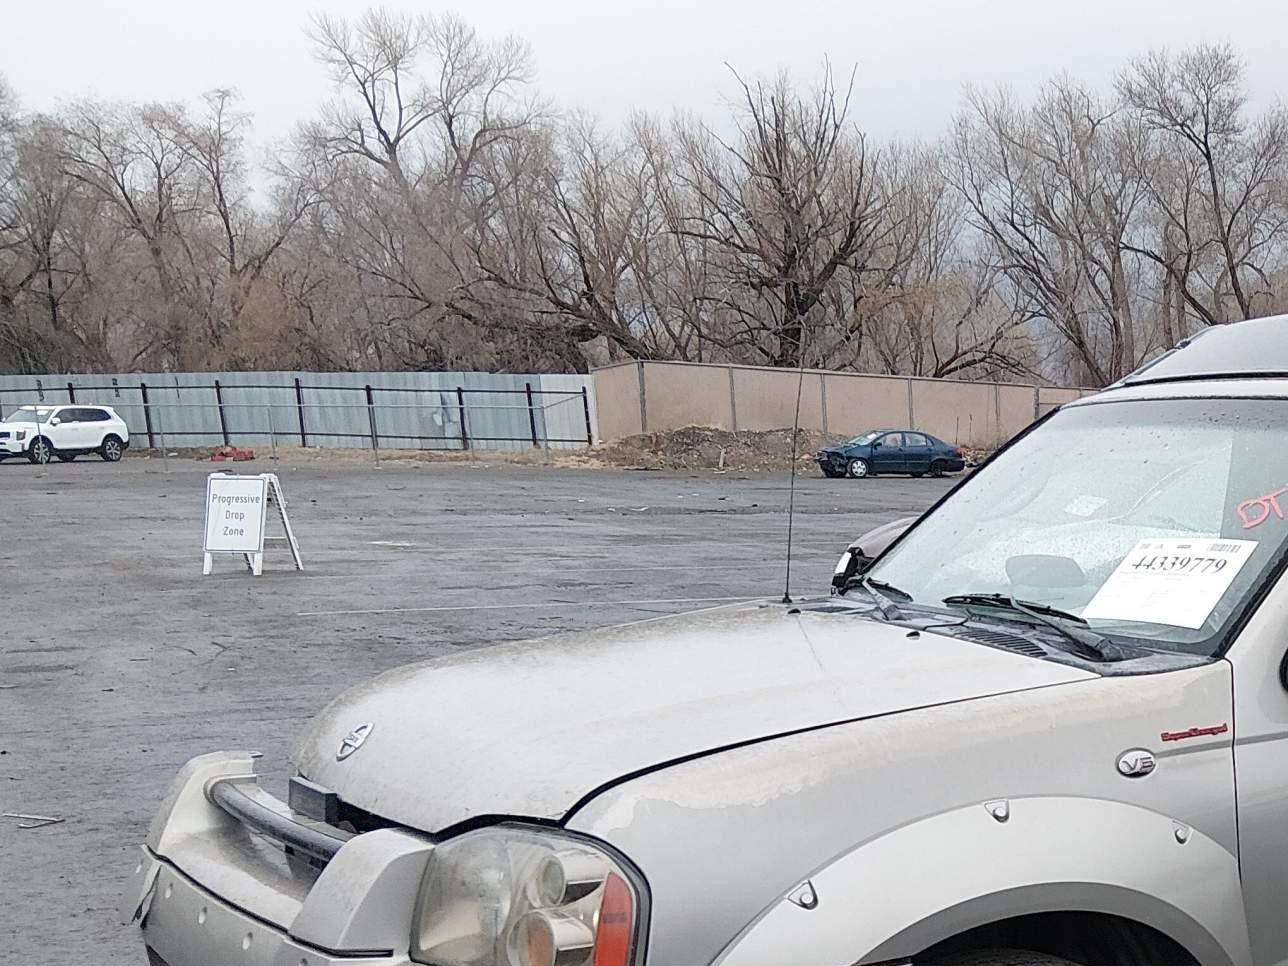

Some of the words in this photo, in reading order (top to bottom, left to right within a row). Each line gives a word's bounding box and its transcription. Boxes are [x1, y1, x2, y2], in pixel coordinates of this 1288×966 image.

[211, 493, 261, 505] Progressive
[225, 510, 245, 522] Drop
[223, 526, 245, 536] Zone
[1132, 555, 1228, 574] 44339779
